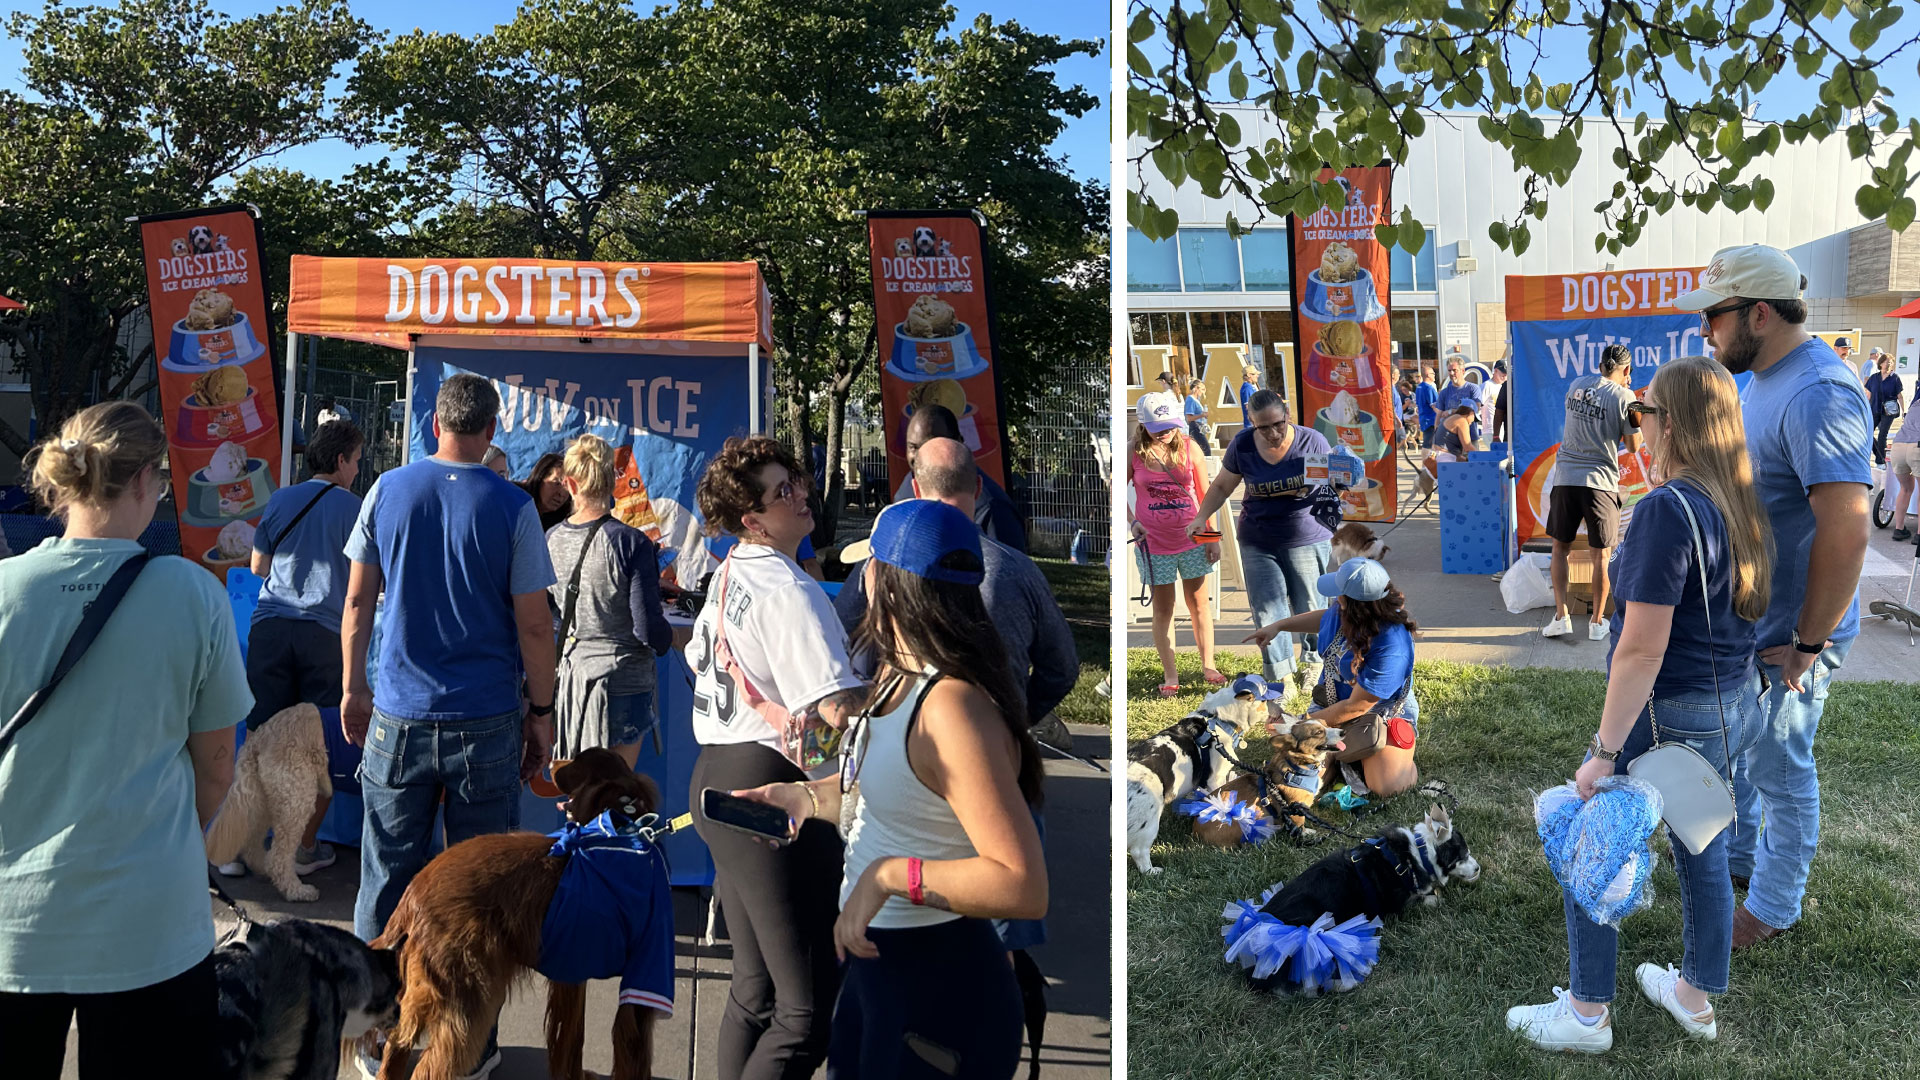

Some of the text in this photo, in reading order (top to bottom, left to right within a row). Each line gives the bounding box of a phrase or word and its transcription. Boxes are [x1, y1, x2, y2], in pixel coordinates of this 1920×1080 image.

[1304, 230, 1317, 241] ICE
[1318, 229, 1347, 241] CREAM
[158, 248, 248, 280] DOGSTERS
[881, 255, 971, 279] DOGSTERS
[162, 281, 178, 292] ICE
[181, 276, 216, 290] CREAM
[886, 281, 899, 292] ICE
[902, 280, 936, 293] CREAM
[1562, 270, 1706, 313] DOGSTER
[385, 264, 642, 328] DOGSTERS
[1635, 346, 1662, 368] ON
[584, 396, 621, 427] ON
[627, 376, 701, 438] ICE
[1567, 398, 1607, 421] DOGSTERS
